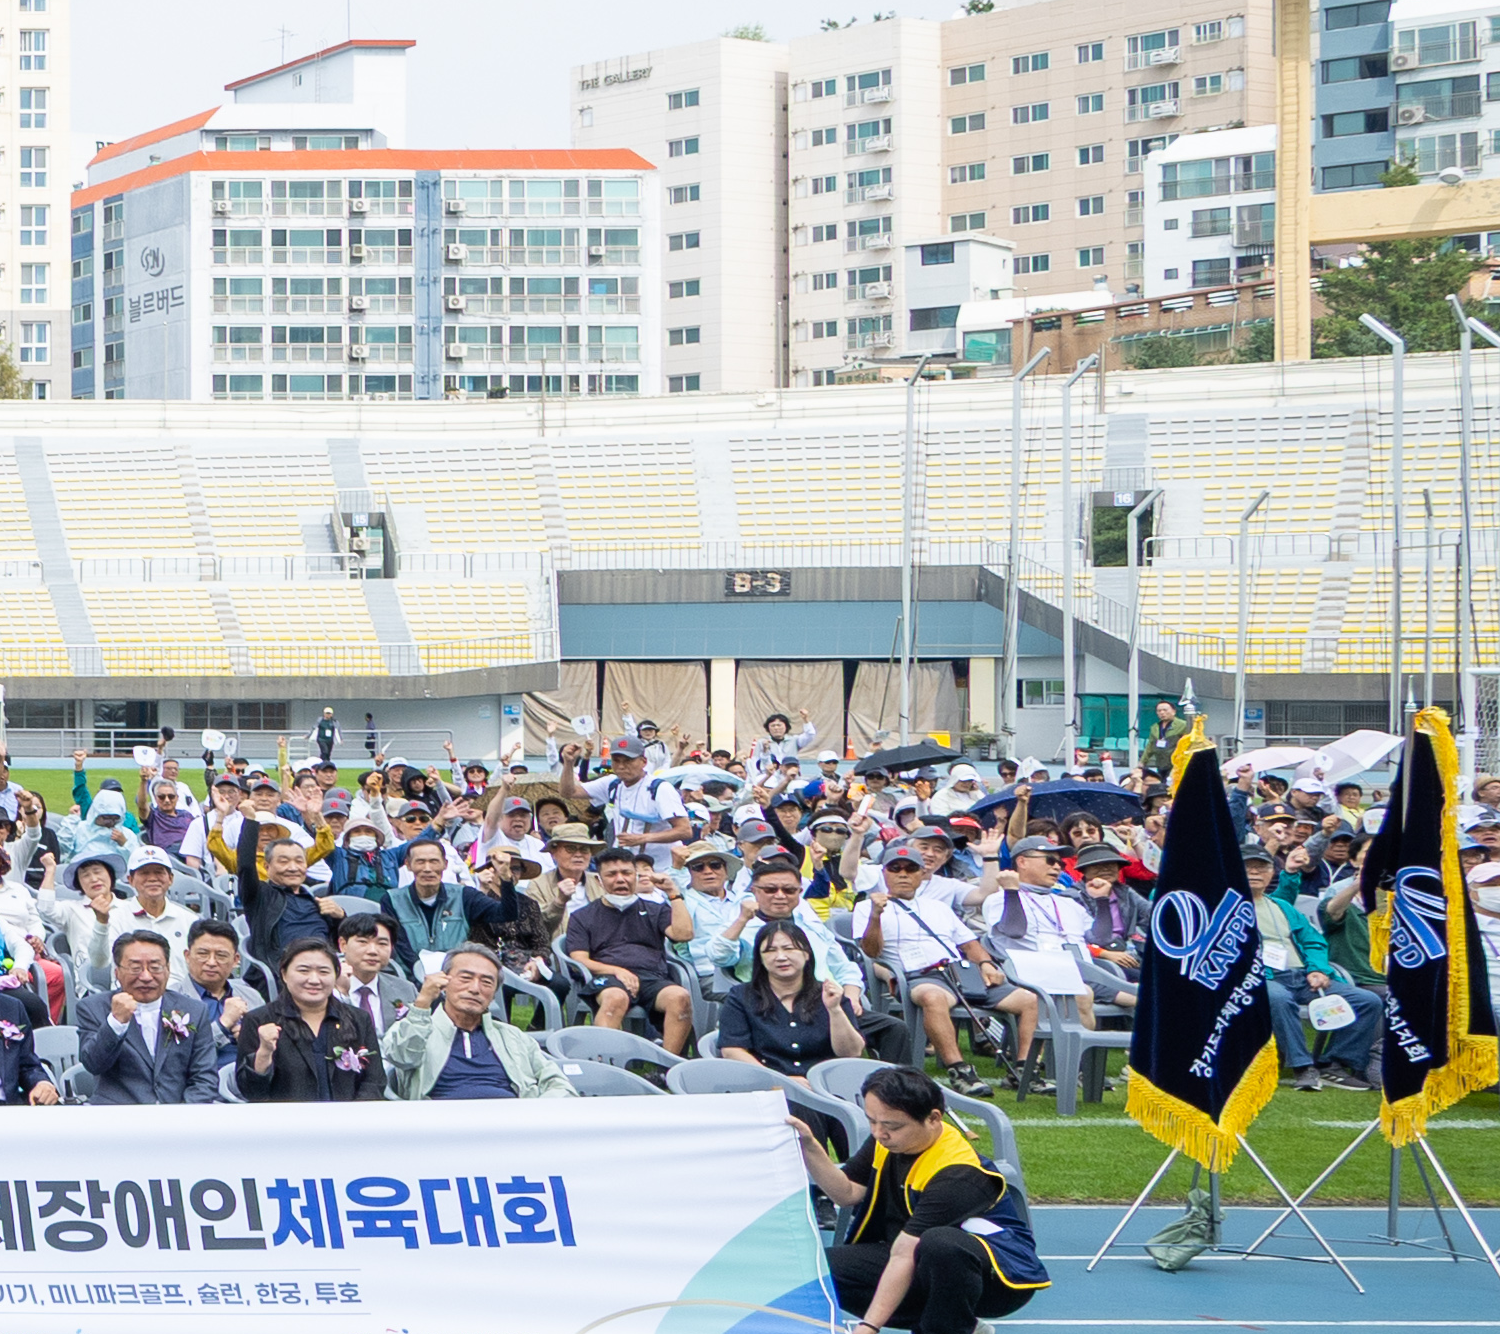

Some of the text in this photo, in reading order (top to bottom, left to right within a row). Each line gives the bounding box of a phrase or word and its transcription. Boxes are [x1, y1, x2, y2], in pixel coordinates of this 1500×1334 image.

[578, 66, 653, 91] THE GALLERY
[128, 285, 185, 324] 블르버드
[1115, 492, 1132, 504] 16
[734, 572, 781, 593] B-3
[1192, 900, 1256, 990] KAPPD
[48, 1283, 192, 1307] 미니파크골프,
[197, 1282, 250, 1307] 슐런,
[255, 1282, 309, 1306] 한궁,
[314, 1281, 362, 1305] 투호
